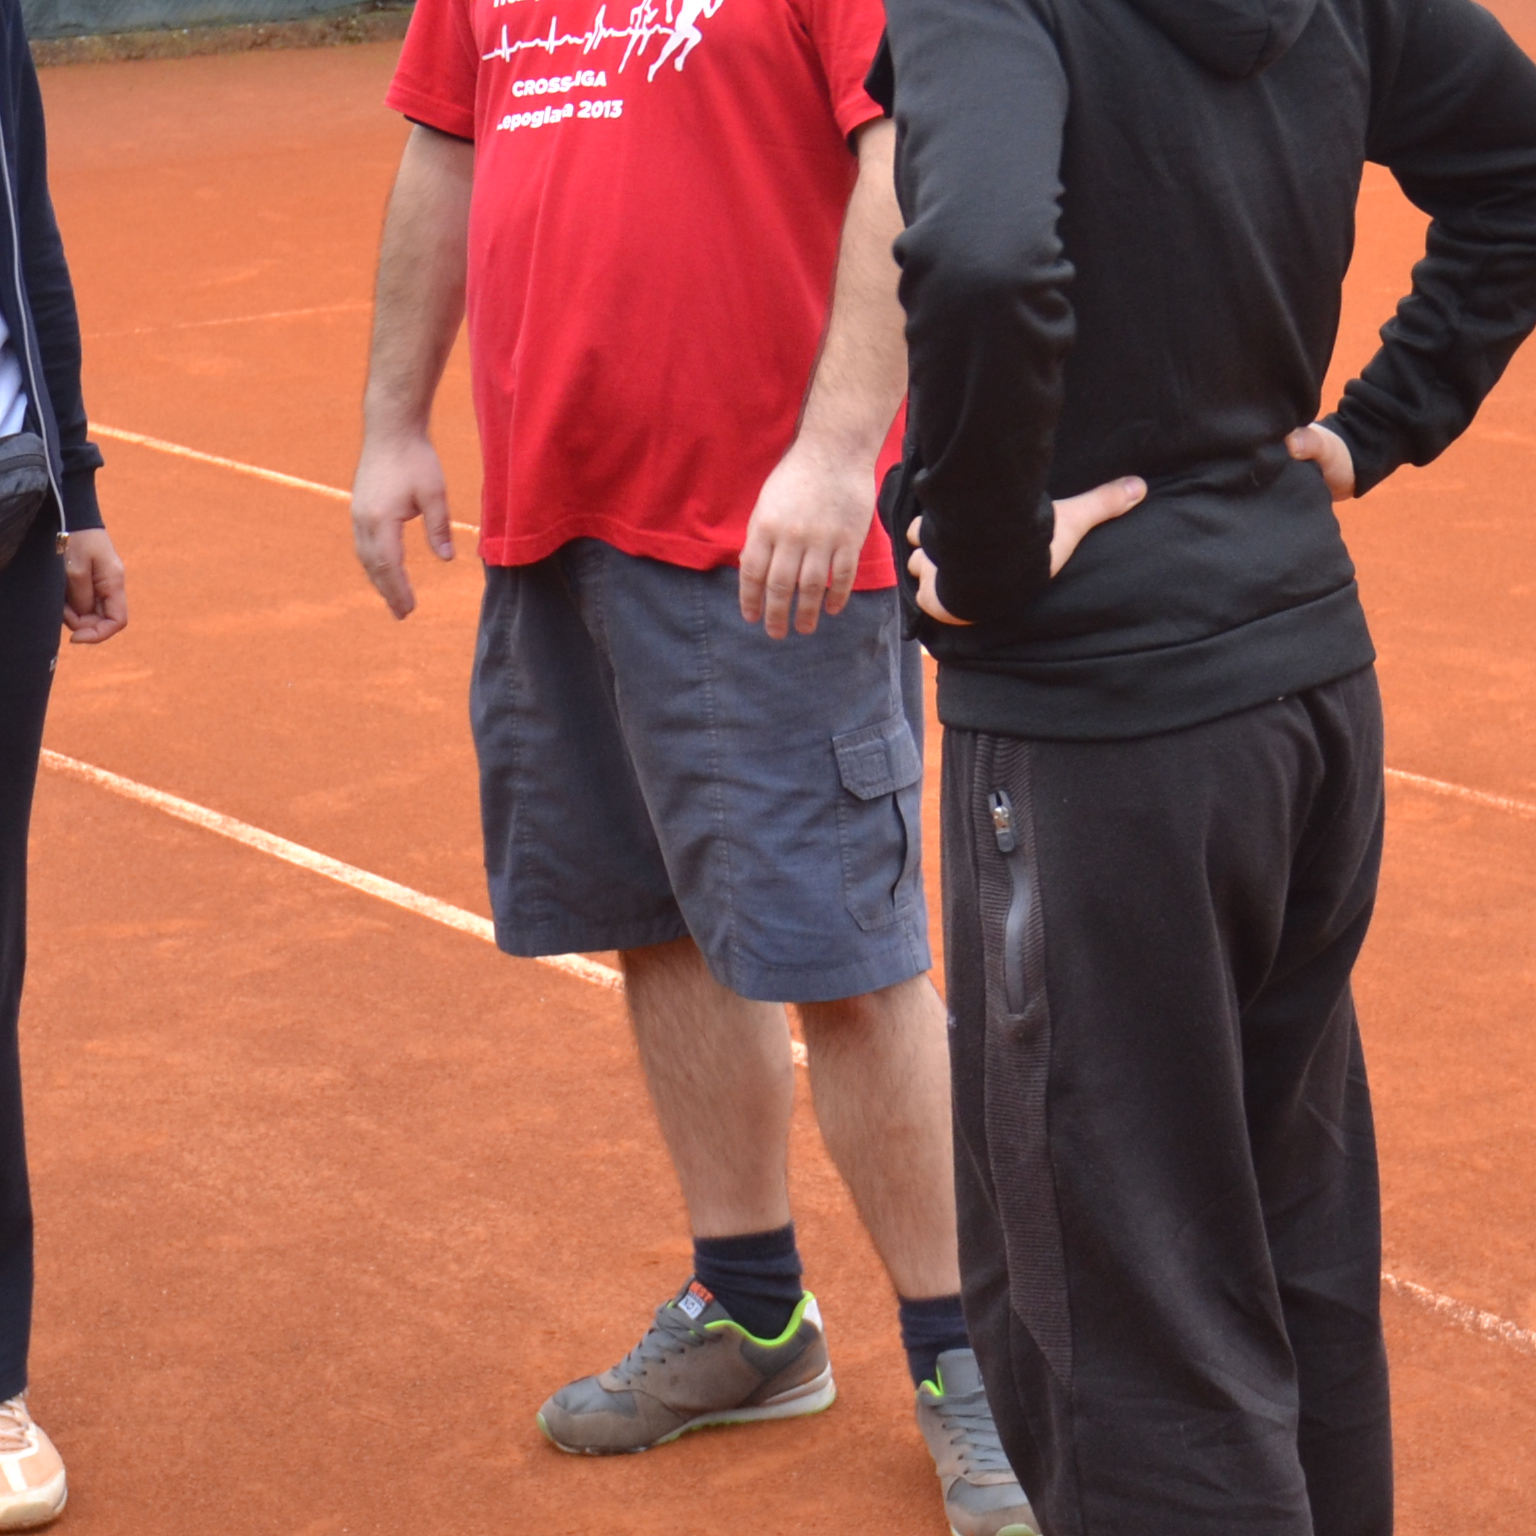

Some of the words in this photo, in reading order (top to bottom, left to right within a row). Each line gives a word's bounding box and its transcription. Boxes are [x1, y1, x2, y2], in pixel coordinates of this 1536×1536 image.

[511, 75, 573, 98] CROSS
[571, 70, 607, 88] IGA
[496, 102, 574, 132] epoglaa
[576, 99, 624, 119] 2013
